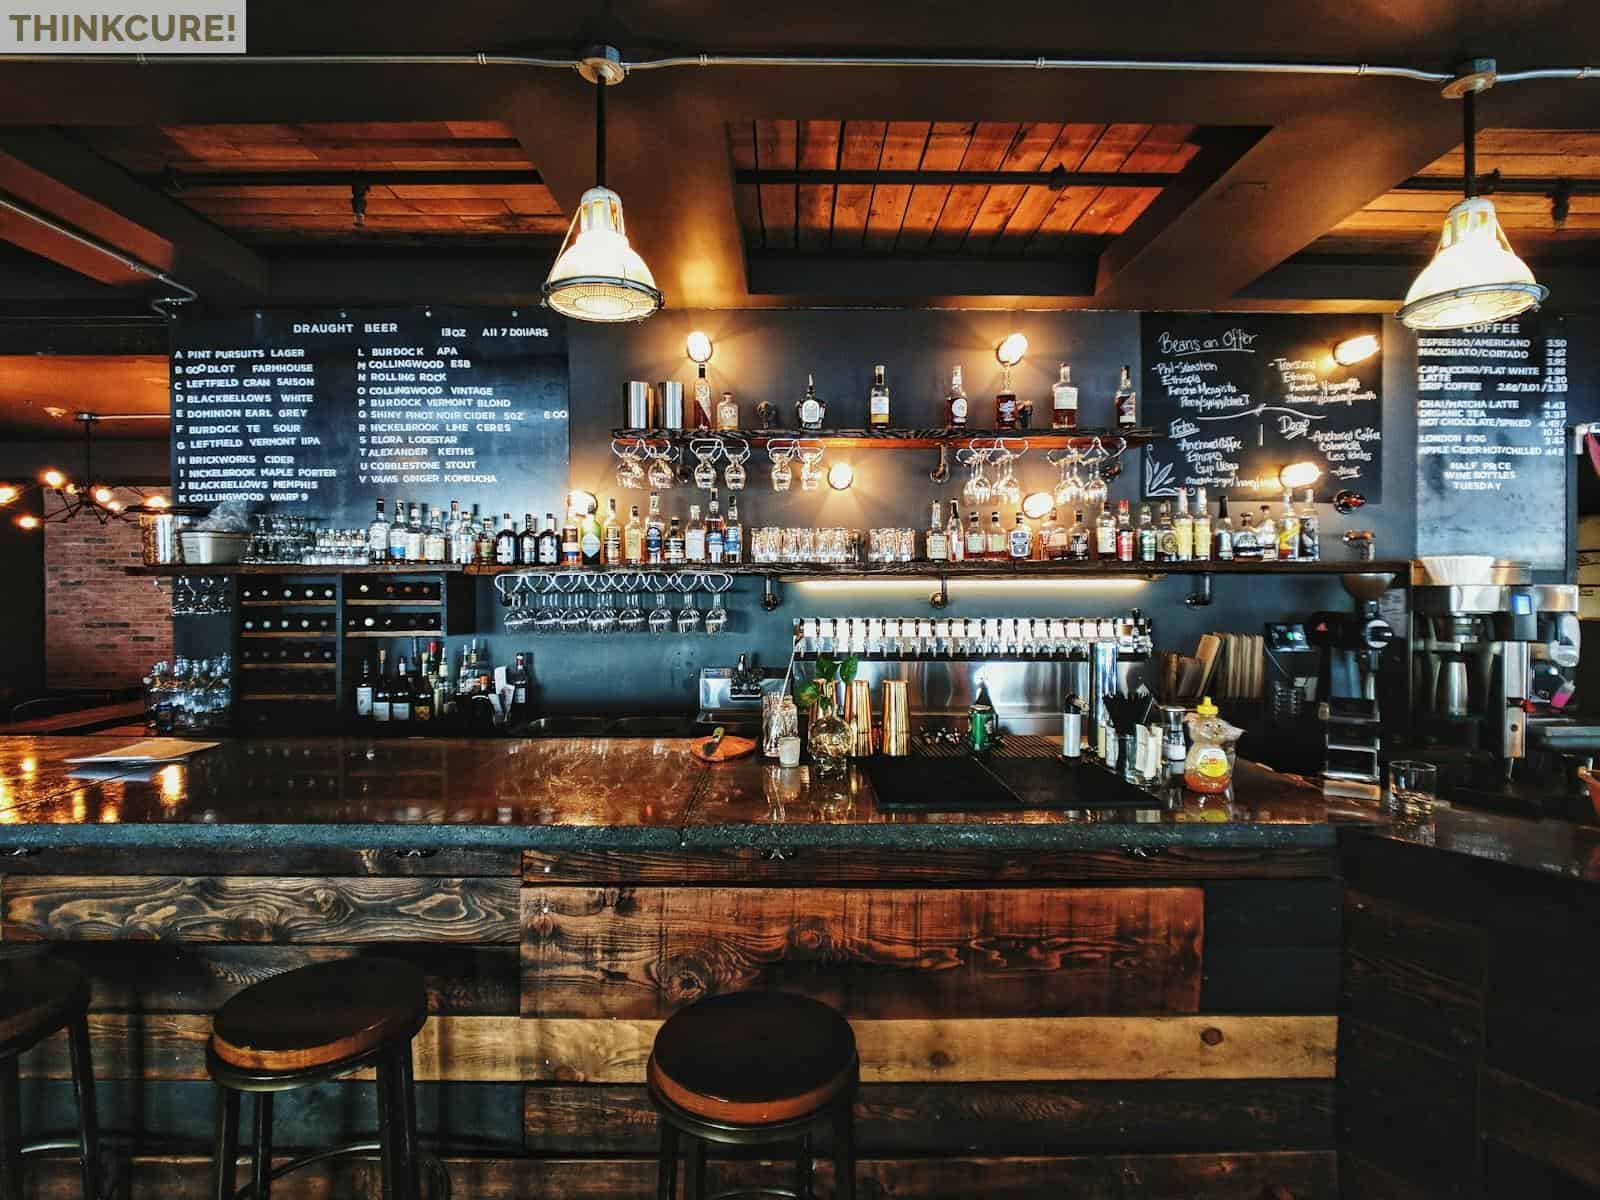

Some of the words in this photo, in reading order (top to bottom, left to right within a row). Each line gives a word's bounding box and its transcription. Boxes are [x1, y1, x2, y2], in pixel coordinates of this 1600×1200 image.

[294, 323, 353, 334] DRAUGHT
[364, 323, 398, 333] BEER
[500, 328, 508, 336] 7
[1463, 323, 1520, 334] COFFEE
[1158, 331, 1200, 354] Beans
[1222, 328, 1258, 351] Offer
[1418, 338, 1531, 348] ESPRESSO/AMERICANO
[174, 350, 183, 359] A
[188, 350, 212, 358] PINT
[215, 350, 264, 358] PURSUITS
[270, 349, 304, 358] LAGER
[358, 348, 364, 356] L
[372, 348, 424, 356] BURDOCK
[436, 347, 458, 356] APA
[1418, 348, 1529, 358] MACCHIATO/CORTADO
[174, 366, 183, 374] B
[252, 364, 313, 372] FARMHOUSE
[357, 362, 366, 370] M
[368, 360, 444, 369] COLLINGWOOD
[450, 360, 471, 368] ESB
[1508, 367, 1540, 376] WHITE
[358, 374, 366, 382] N
[371, 373, 416, 382] ROLLING
[419, 373, 447, 382] ROCK
[1418, 374, 1452, 382] LATTE
[174, 382, 182, 390] C
[186, 379, 239, 388] LEFTFIELD
[243, 379, 271, 388] CRAN
[276, 378, 315, 386] SAISON
[1445, 382, 1482, 392] COFFEE
[357, 386, 366, 395] O
[368, 386, 442, 396] COLLINGWOOD
[450, 387, 494, 396] VINTAGE
[176, 394, 184, 402] D
[186, 394, 272, 403] BLACKBELLOWS
[280, 394, 313, 402] WHITE
[358, 399, 366, 407] P
[370, 399, 422, 407] BURDOCK
[426, 398, 473, 407] VERMONT
[476, 399, 512, 408] BLOND
[1418, 400, 1488, 408] CHAI/MATCHA
[1488, 400, 1520, 408] LATTE
[176, 409, 184, 418] E
[187, 408, 241, 418] DOMINION
[244, 408, 272, 418] EARL
[278, 408, 308, 418] GREY
[370, 410, 402, 419] SHINY
[406, 412, 433, 420] PINOT
[436, 412, 460, 420] NOIR
[464, 412, 496, 420] CIDER
[1418, 410, 1464, 418] ORGANIC
[1467, 410, 1486, 418] TEA
[176, 424, 184, 432] F
[188, 424, 240, 434] BURDOCK
[273, 424, 301, 432] SOUR
[358, 424, 366, 432] R
[370, 424, 438, 432] NICKELBROOK
[446, 424, 469, 432] LIME
[476, 424, 512, 432] CERES
[177, 442, 185, 450] G
[190, 438, 244, 448] LEFTFIELD
[250, 437, 296, 446] VERMONT
[360, 436, 368, 444] S
[370, 436, 402, 444] ELORA
[408, 436, 458, 444] LODESTAR
[1418, 435, 1462, 443] LONDON
[1465, 435, 1488, 443] FOG
[360, 448, 367, 456] T
[368, 448, 428, 456] ALEXANDER
[438, 448, 475, 456] KEITHS
[1452, 446, 1482, 454] CIDER
[178, 456, 186, 464] H
[189, 455, 256, 464] BRICKWORKS
[264, 456, 294, 464] CIDER
[360, 462, 368, 470] U
[370, 462, 440, 470] COBBLESTONE
[446, 461, 477, 470] STOUT
[1450, 462, 1476, 470] HALF
[1482, 462, 1512, 471] PRICE
[188, 468, 256, 478] NICKELBROOK
[260, 468, 294, 477] MAPLE
[298, 468, 337, 478] PORTER
[1443, 472, 1472, 480] WINE
[1473, 472, 1516, 480] BOTTLES
[358, 476, 368, 484] V
[402, 474, 440, 482] GINGER
[444, 474, 497, 482] KOMBUCHA
[178, 482, 186, 490] J
[188, 481, 268, 490] BLACKBELLOWS
[272, 480, 318, 489] MEMPHIS
[1455, 482, 1502, 491] TUESDAY
[178, 494, 186, 503] K
[188, 493, 264, 502] COLLINGWOOD
[270, 493, 298, 502] WARP
